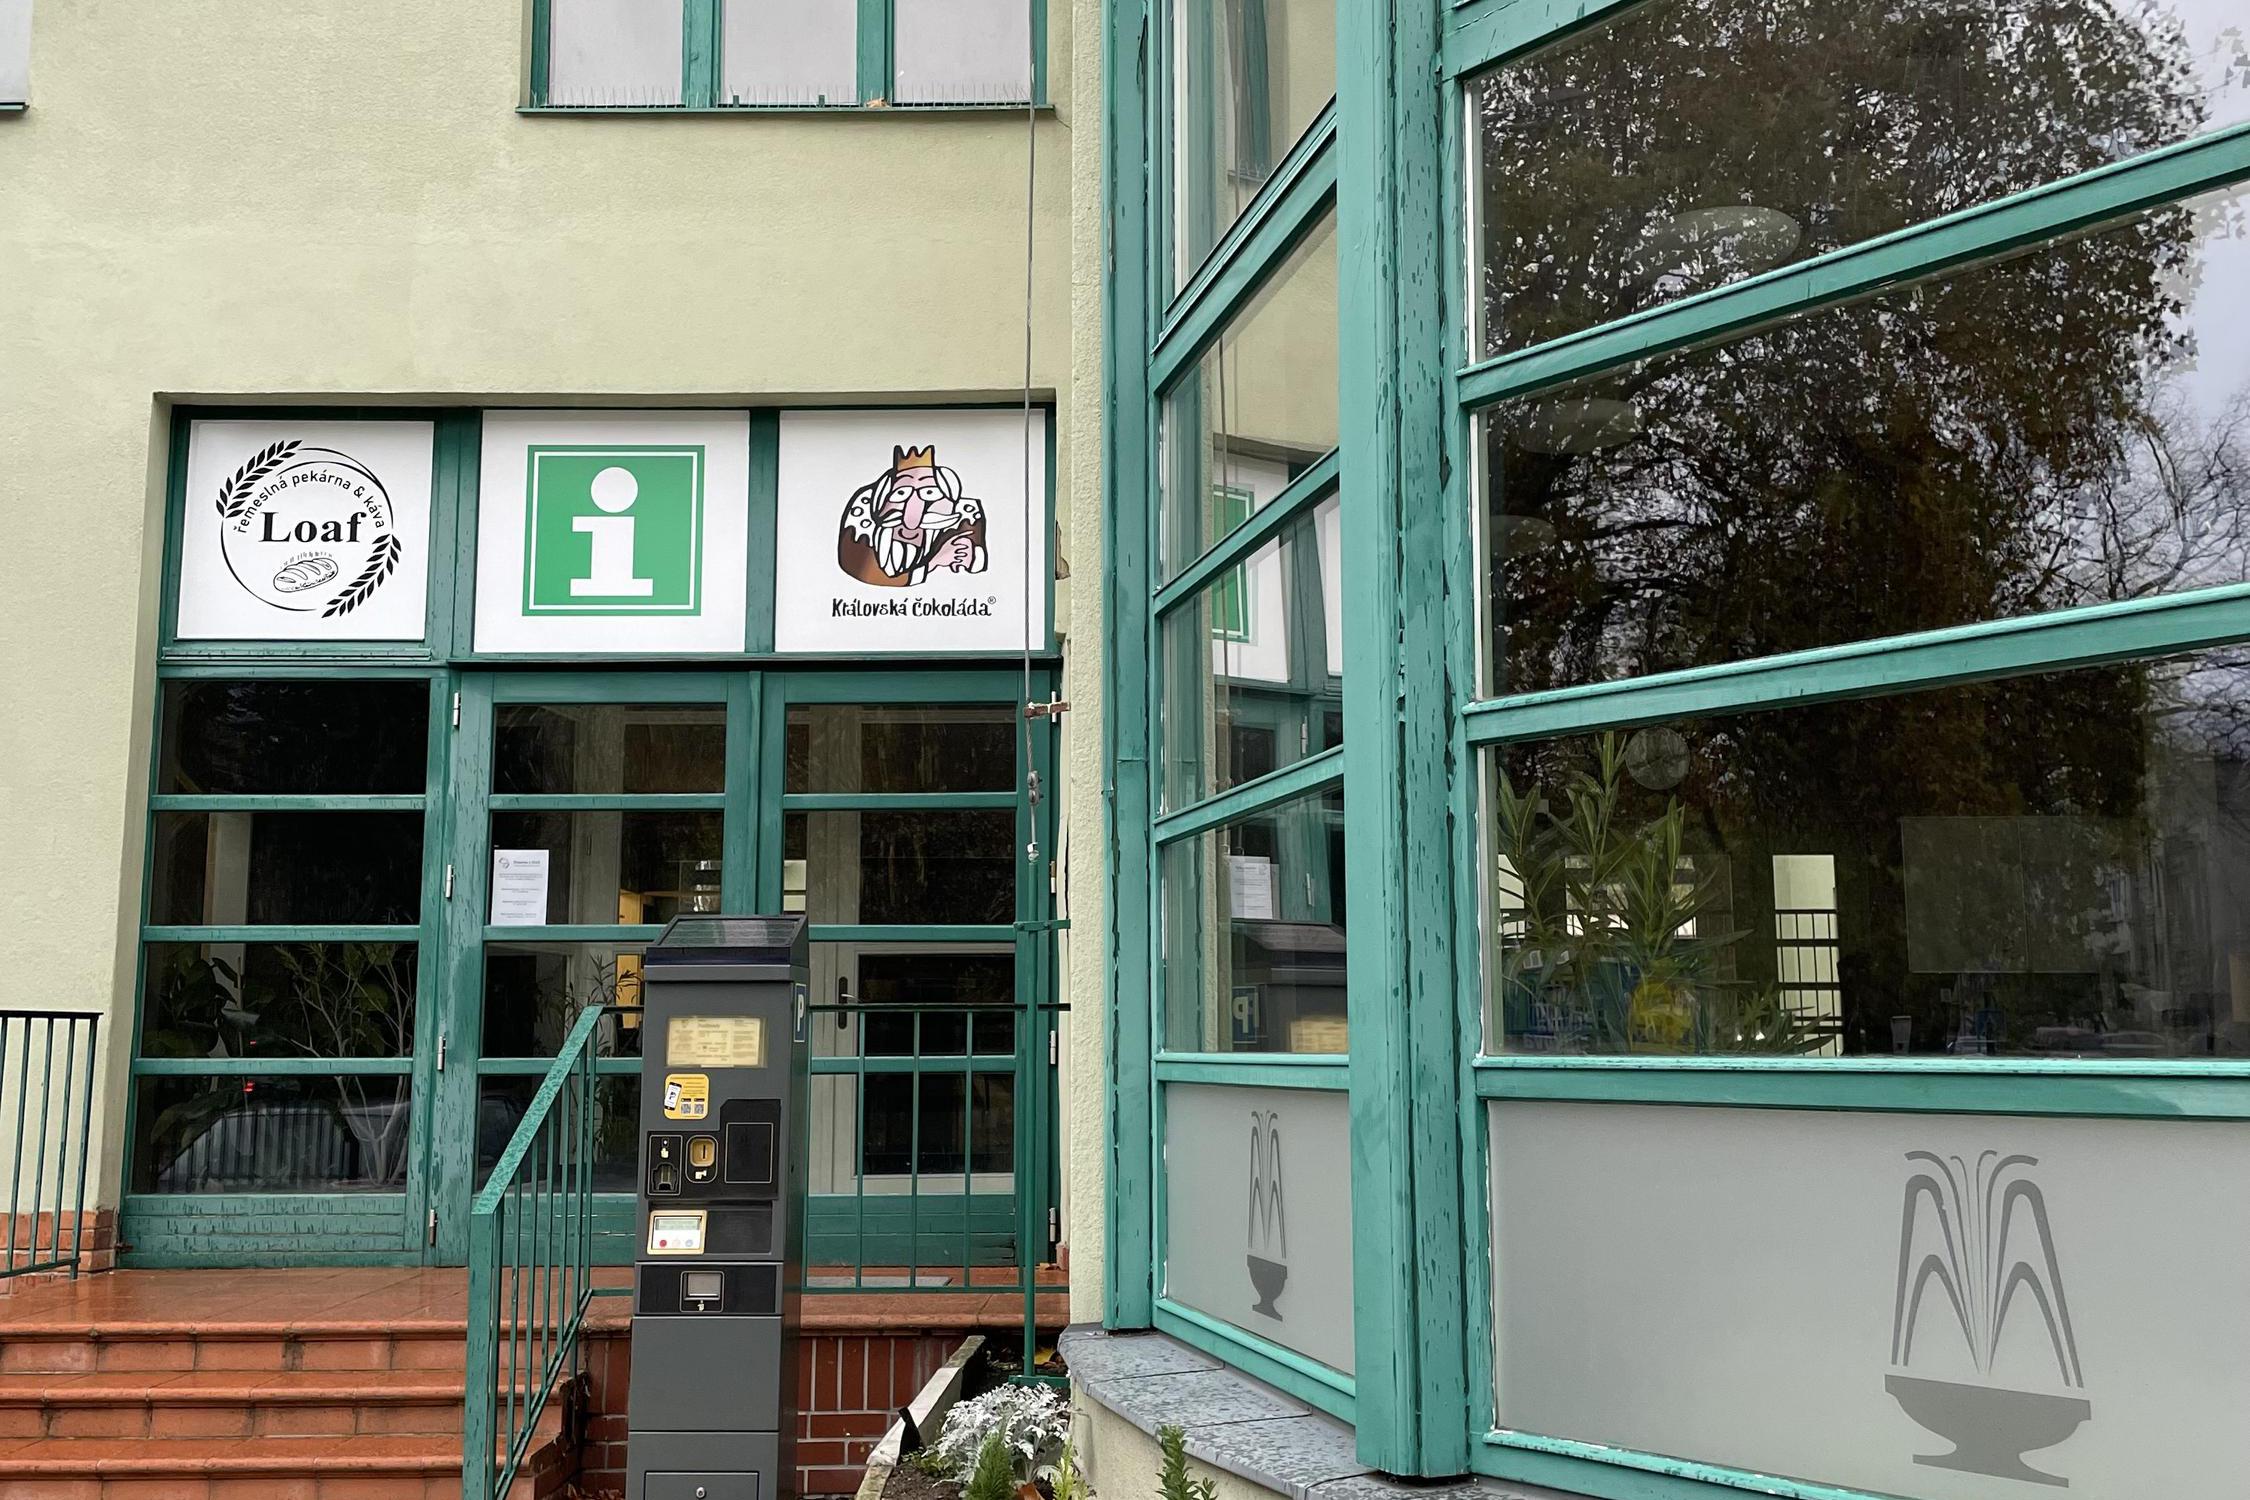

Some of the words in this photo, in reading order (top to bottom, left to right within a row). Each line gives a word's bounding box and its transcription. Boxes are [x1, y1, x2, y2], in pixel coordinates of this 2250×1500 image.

[233, 476, 288, 534] řemeslná
[292, 470, 351, 490] pekárna
[353, 485, 365, 498] &
[363, 495, 385, 529] káva
[258, 511, 367, 543] Loaf
[831, 598, 908, 618] Královská
[797, 993, 804, 1032] P
